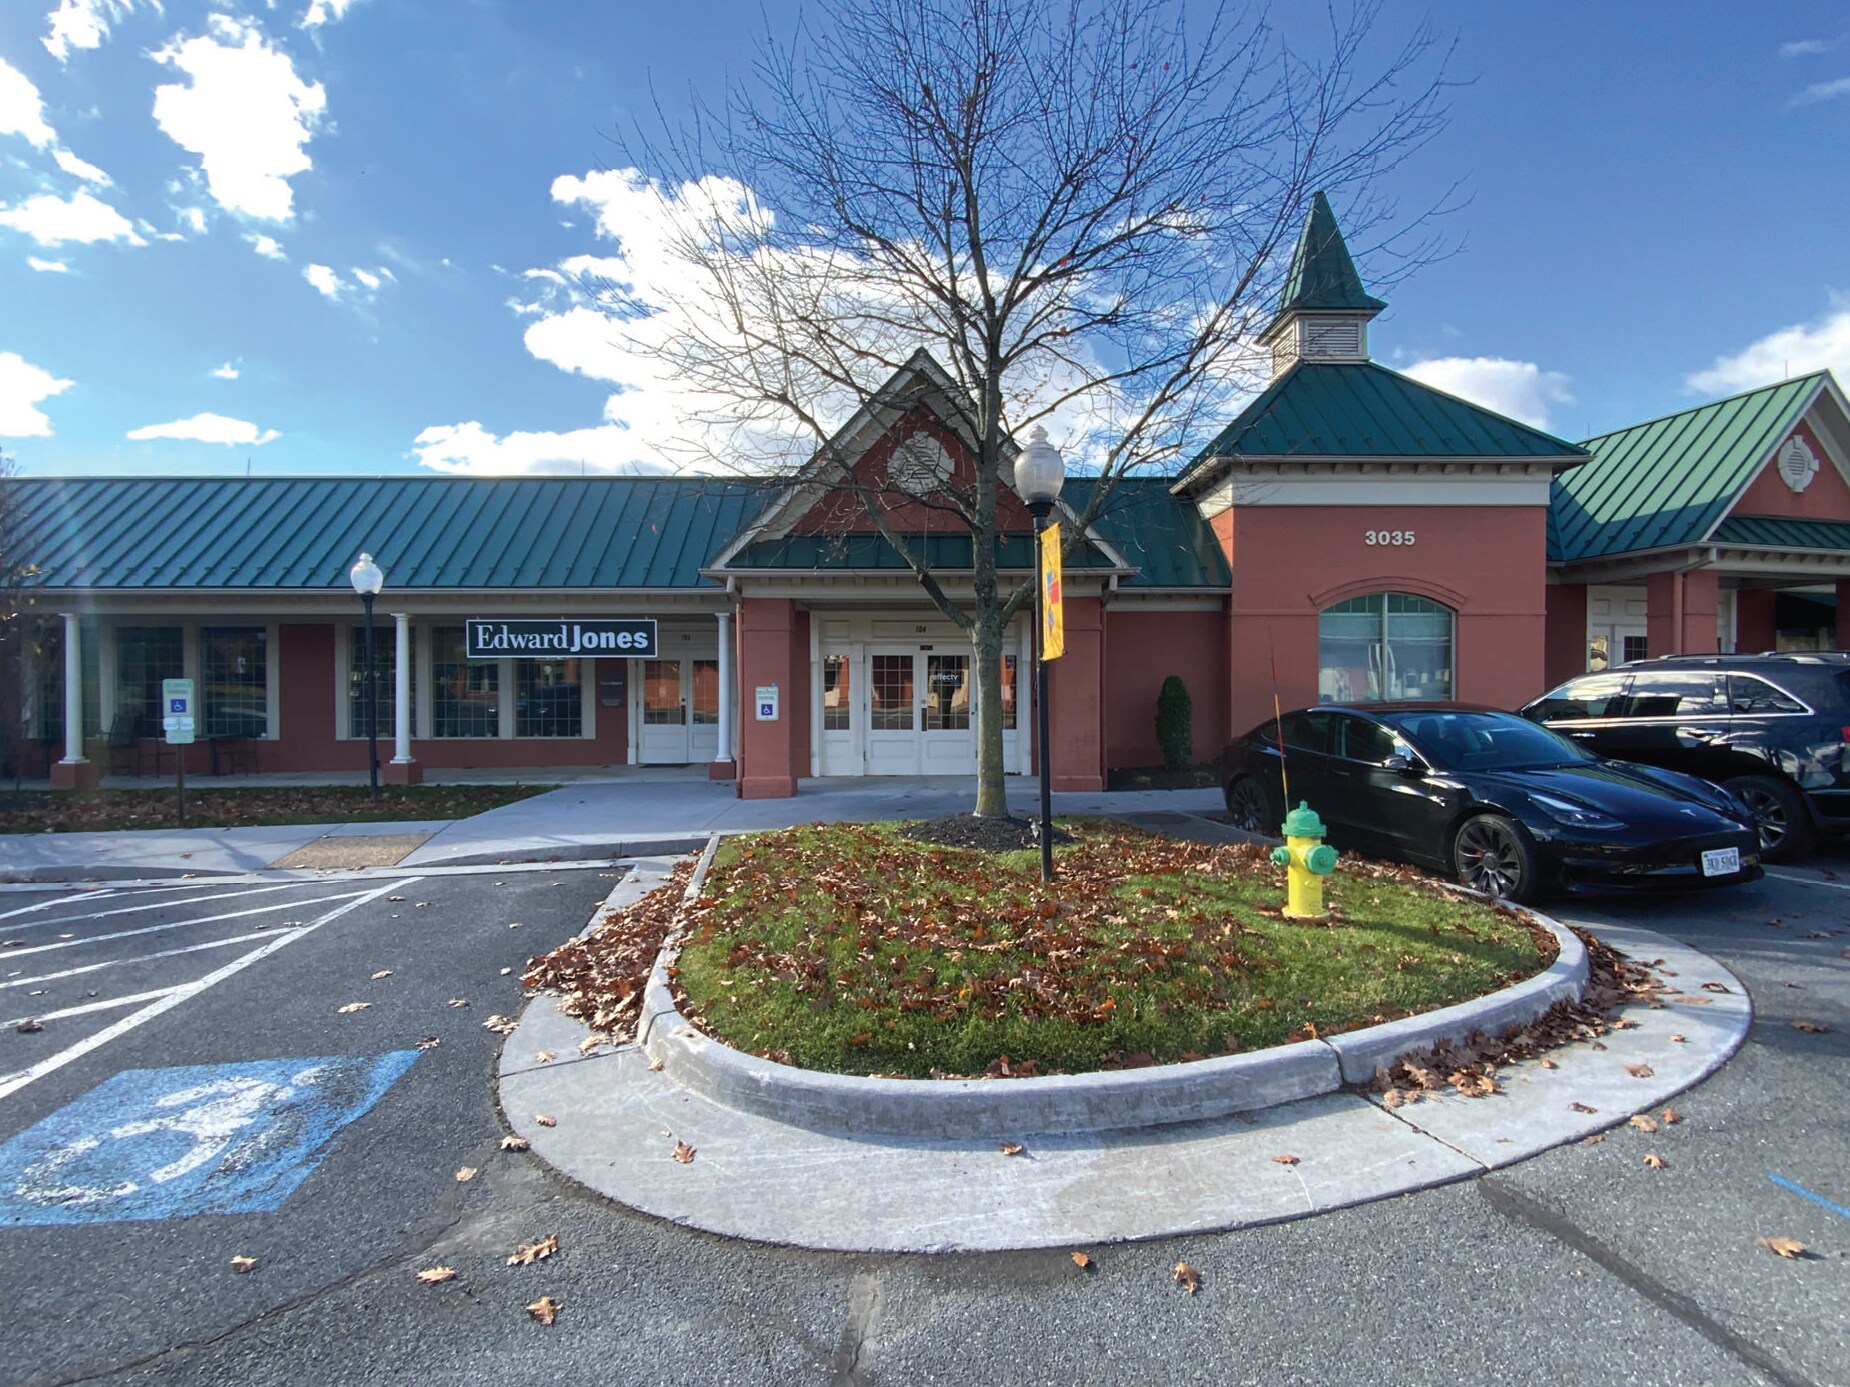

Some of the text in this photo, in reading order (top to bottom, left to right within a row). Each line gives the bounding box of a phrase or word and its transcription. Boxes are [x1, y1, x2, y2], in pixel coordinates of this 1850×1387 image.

[1365, 530, 1416, 546] 3035
[475, 624, 649, 652] Edward Jones
